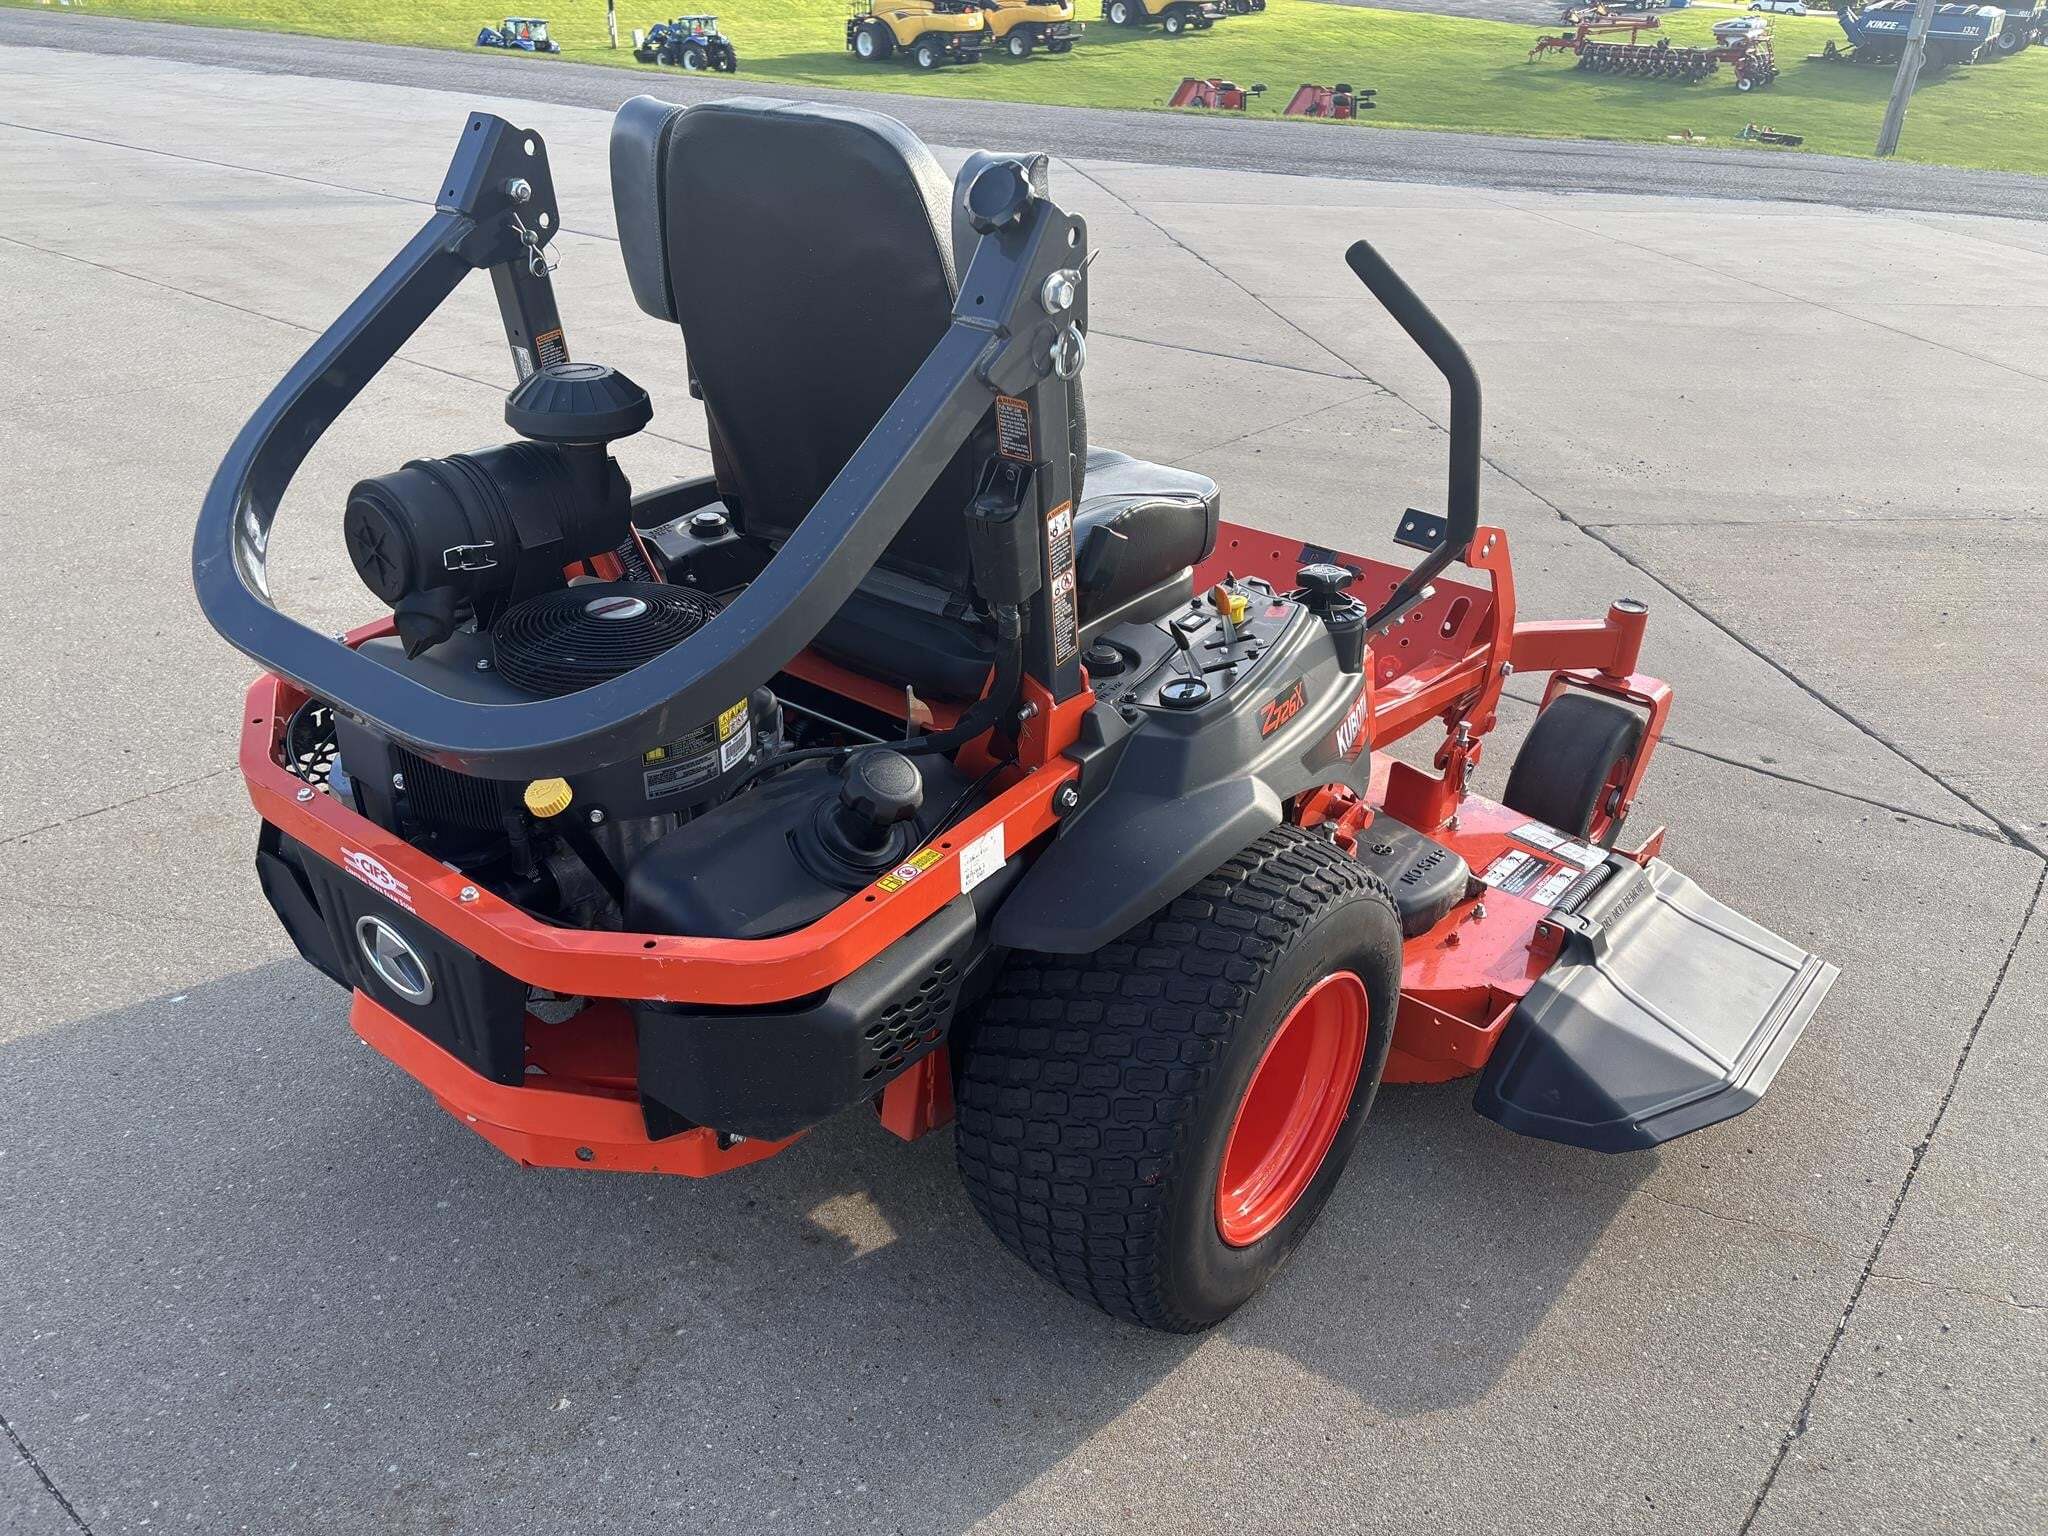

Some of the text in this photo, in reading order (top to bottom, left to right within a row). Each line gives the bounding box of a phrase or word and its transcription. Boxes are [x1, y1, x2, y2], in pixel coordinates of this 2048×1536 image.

[1865, 20, 1899, 30] KINZE
[1260, 682, 1304, 736] Z726X
[1336, 690, 1367, 758] KUBOT
[360, 859, 390, 885] CIFS
[1400, 849, 1446, 885] NO STEP
[1601, 879, 1647, 931] DO NOT REMOVE
